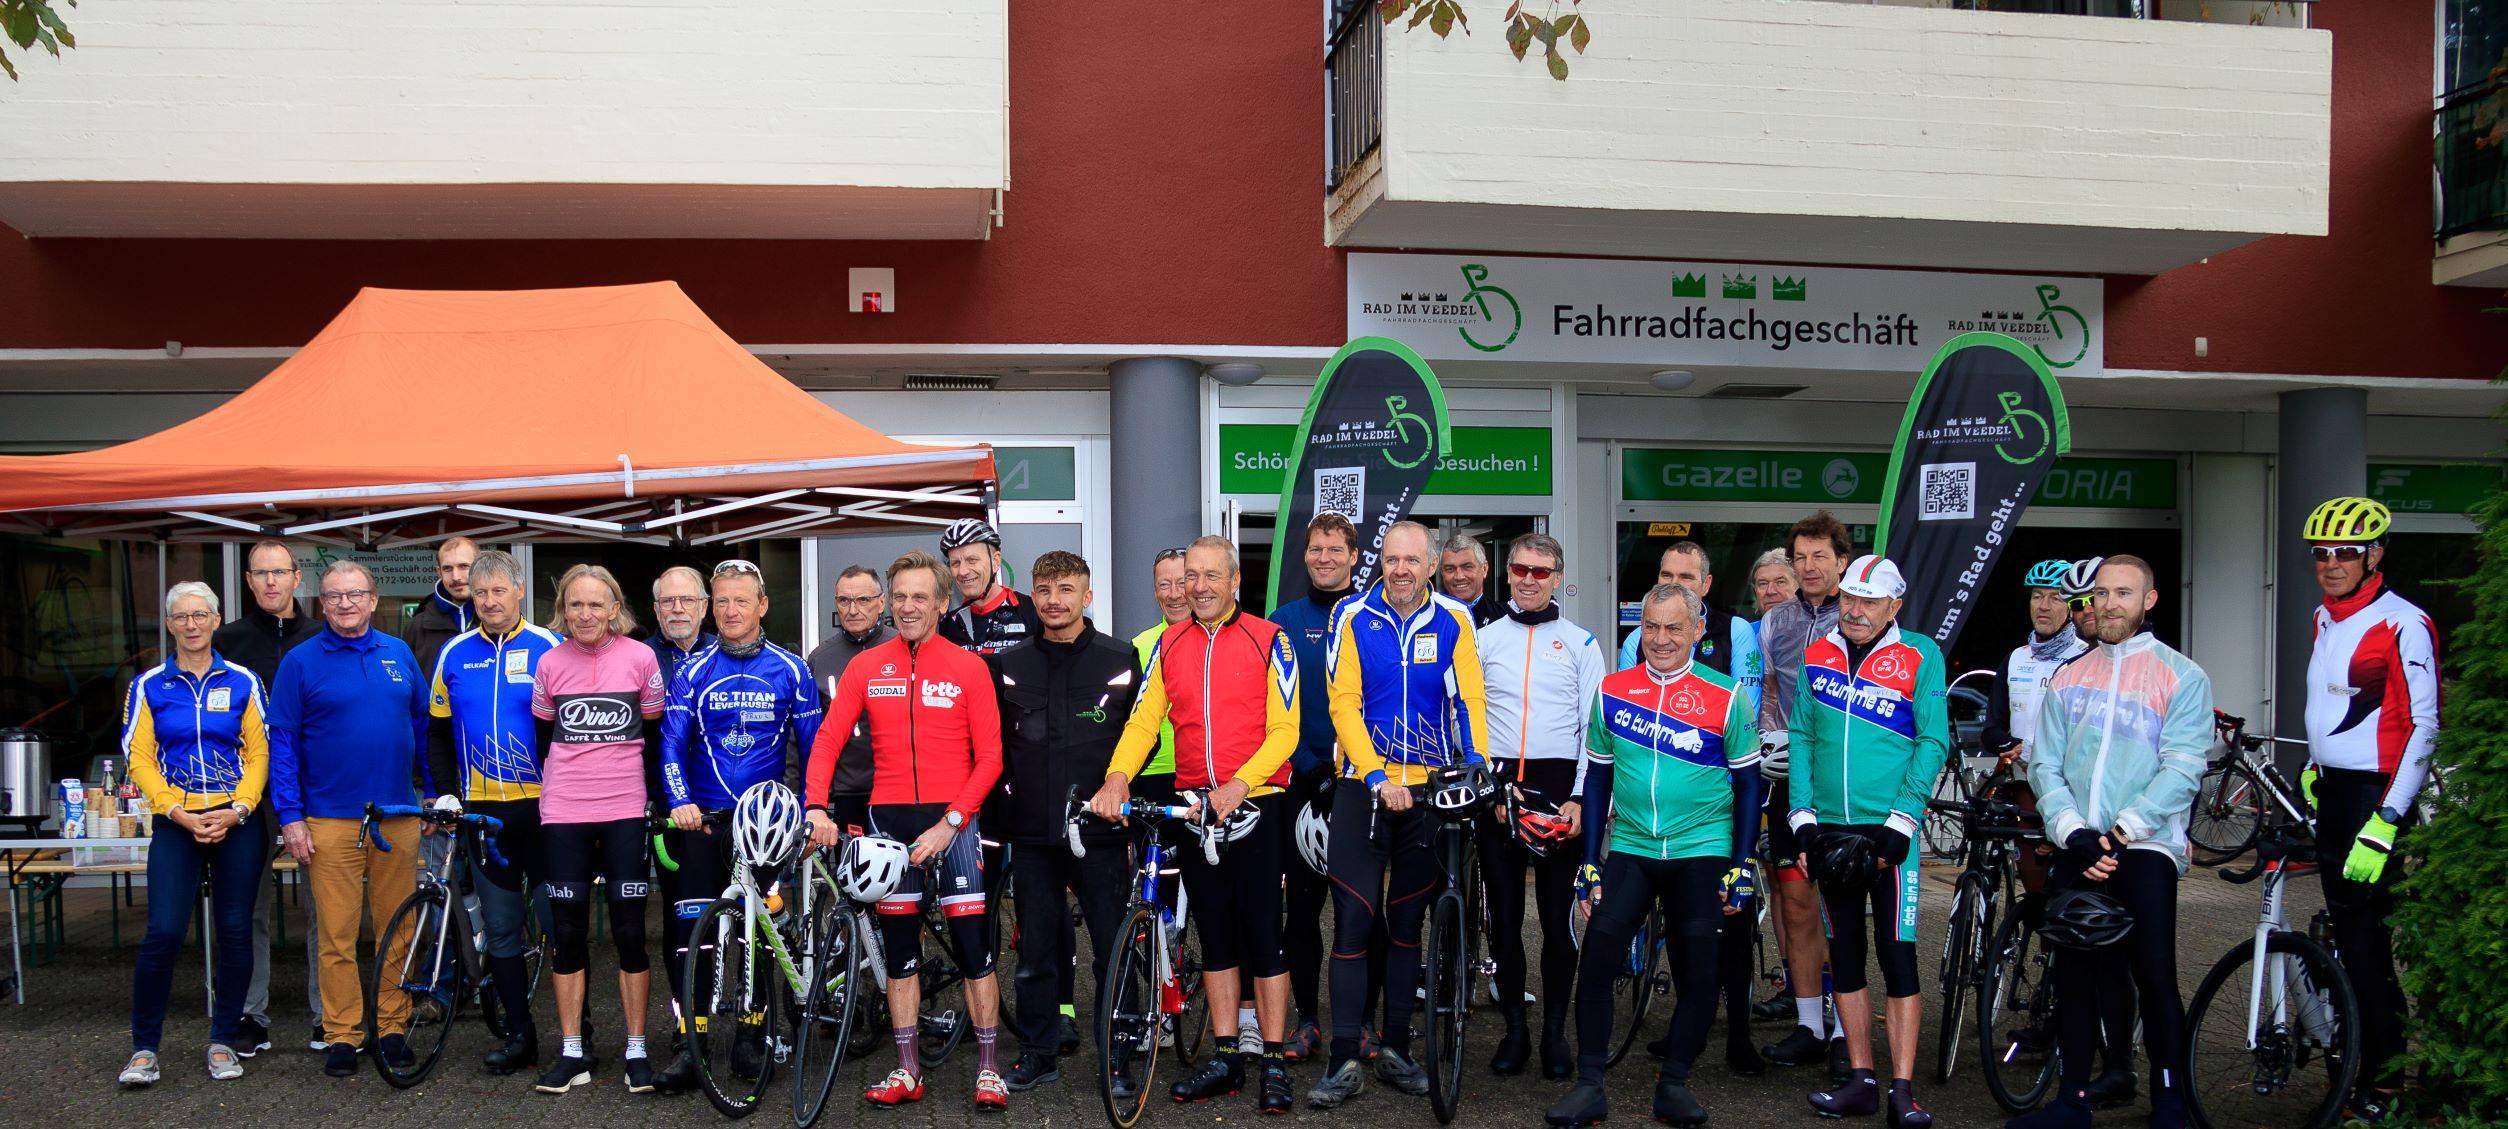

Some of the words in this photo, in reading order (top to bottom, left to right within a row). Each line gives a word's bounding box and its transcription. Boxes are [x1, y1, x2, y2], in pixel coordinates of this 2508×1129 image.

[1363, 303, 1392, 314] RAD
[1397, 304, 1417, 315] IM
[1421, 303, 1477, 316] VEEDEL
[1553, 304, 1918, 350] Fahrradfachgeschäft
[1948, 320, 1974, 331] RAD
[1978, 321, 1996, 332] IM
[2000, 322, 2050, 334] VEEDEL
[1311, 433, 1333, 444] RAD
[1336, 430, 1351, 442] IM
[1354, 428, 1398, 441] VEEDEL
[1917, 429, 1940, 440] RAD
[1943, 427, 1960, 438] IM
[1963, 426, 2012, 437] VEEDEL
[1662, 461, 1803, 489] Gazelle
[2042, 469, 2133, 501] ORIA
[1351, 551, 1378, 592] Rad
[1373, 502, 1401, 549] geht
[1958, 545, 1992, 589] Rad
[1986, 497, 2015, 546] geht
[348, 554, 414, 562] Sammlerstücke
[418, 553, 433, 562] und
[382, 564, 420, 573] Geschäft
[709, 692, 728, 701] RC
[732, 691, 775, 702] TITAN
[869, 688, 905, 696] SOUDAL
[922, 679, 962, 697] lotto
[564, 701, 628, 726] Dino's
[709, 701, 775, 710] LEVERKUSEN
[1876, 699, 1896, 718] se
[1630, 713, 1676, 745] kumm
[1906, 870, 1918, 884] se
[1906, 884, 1918, 904] sin
